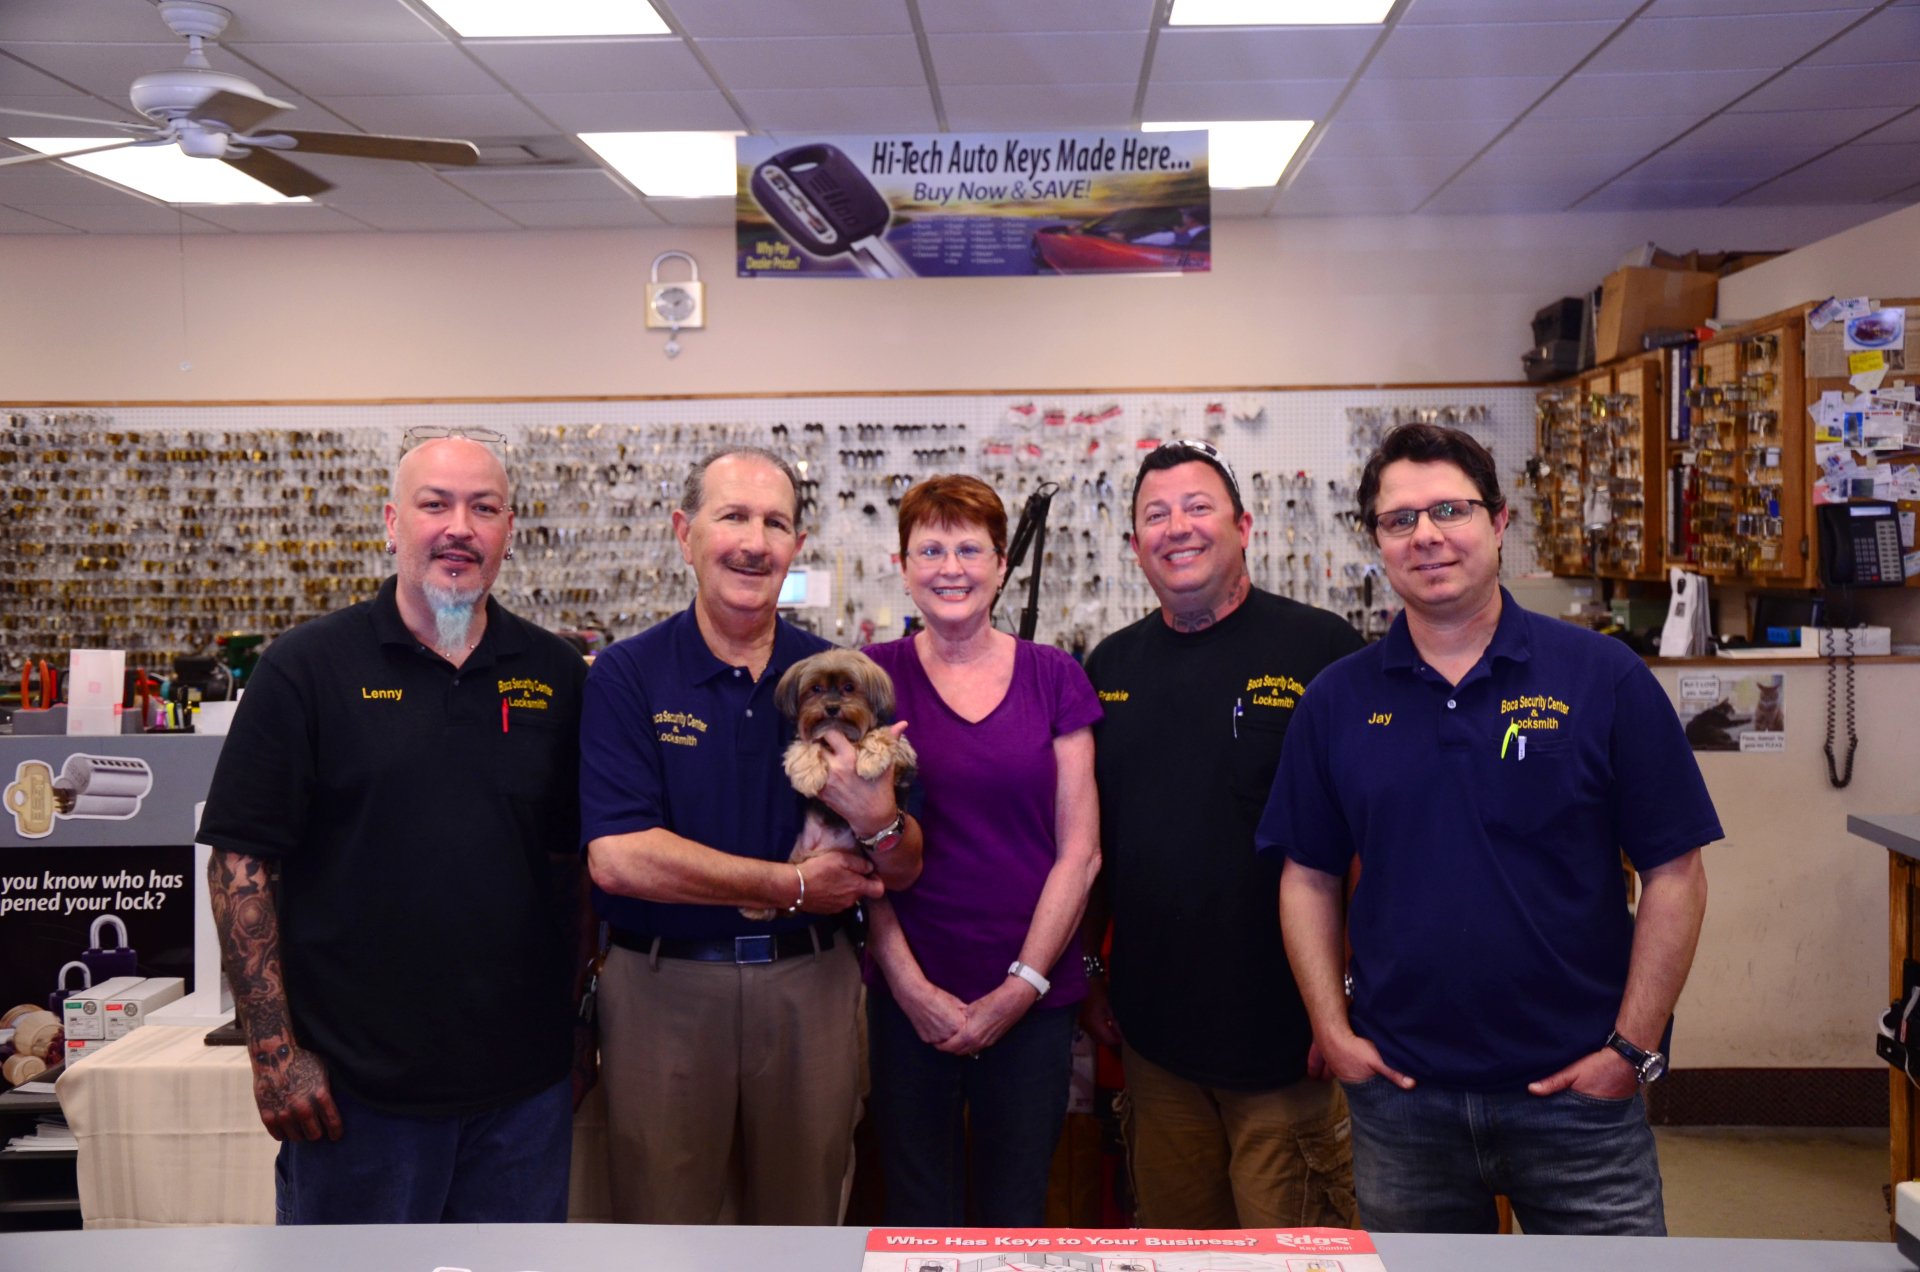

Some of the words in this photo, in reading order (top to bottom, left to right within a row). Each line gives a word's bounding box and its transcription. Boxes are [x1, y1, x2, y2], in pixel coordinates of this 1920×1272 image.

[872, 140, 943, 175] Hi-Tech
[947, 140, 998, 174] Auto
[1003, 138, 1051, 181] Keys
[1056, 138, 1115, 173] Made
[1121, 138, 1190, 172] Here...
[913, 182, 954, 206] Buy
[959, 181, 1007, 201] Now
[1010, 180, 1025, 200] &
[1030, 179, 1092, 200] SAVE!
[756, 241, 773, 258] Why
[774, 241, 790, 258] Pay
[512, 677, 534, 692] Security
[535, 680, 553, 697] Center
[1246, 679, 1263, 691] Boca
[1263, 674, 1287, 691] Security
[362, 687, 402, 701] Lenny
[1098, 690, 1129, 702] Frankie
[1271, 688, 1279, 696] &
[508, 696, 548, 709] Locksmith
[1253, 694, 1294, 709] Locksmith
[1500, 699, 1518, 715] Boca
[1519, 694, 1547, 711] Security
[1547, 696, 1570, 715] Center
[663, 710, 686, 728] Security
[687, 713, 708, 732] Center
[1368, 712, 1392, 727] Jay
[1531, 708, 1539, 718] &
[1, 876, 38, 895] you
[43, 870, 98, 890] know
[102, 869, 144, 889] who
[149, 869, 183, 889] has
[0, 892, 61, 916] pened
[64, 896, 112, 916] your
[115, 891, 166, 910] lock?
[886, 1236, 938, 1246] Who
[945, 1237, 988, 1247] Has
[994, 1237, 1051, 1247] Keys
[1056, 1237, 1082, 1246] to
[1084, 1237, 1140, 1246] Your
[1145, 1237, 1259, 1247] Business?
